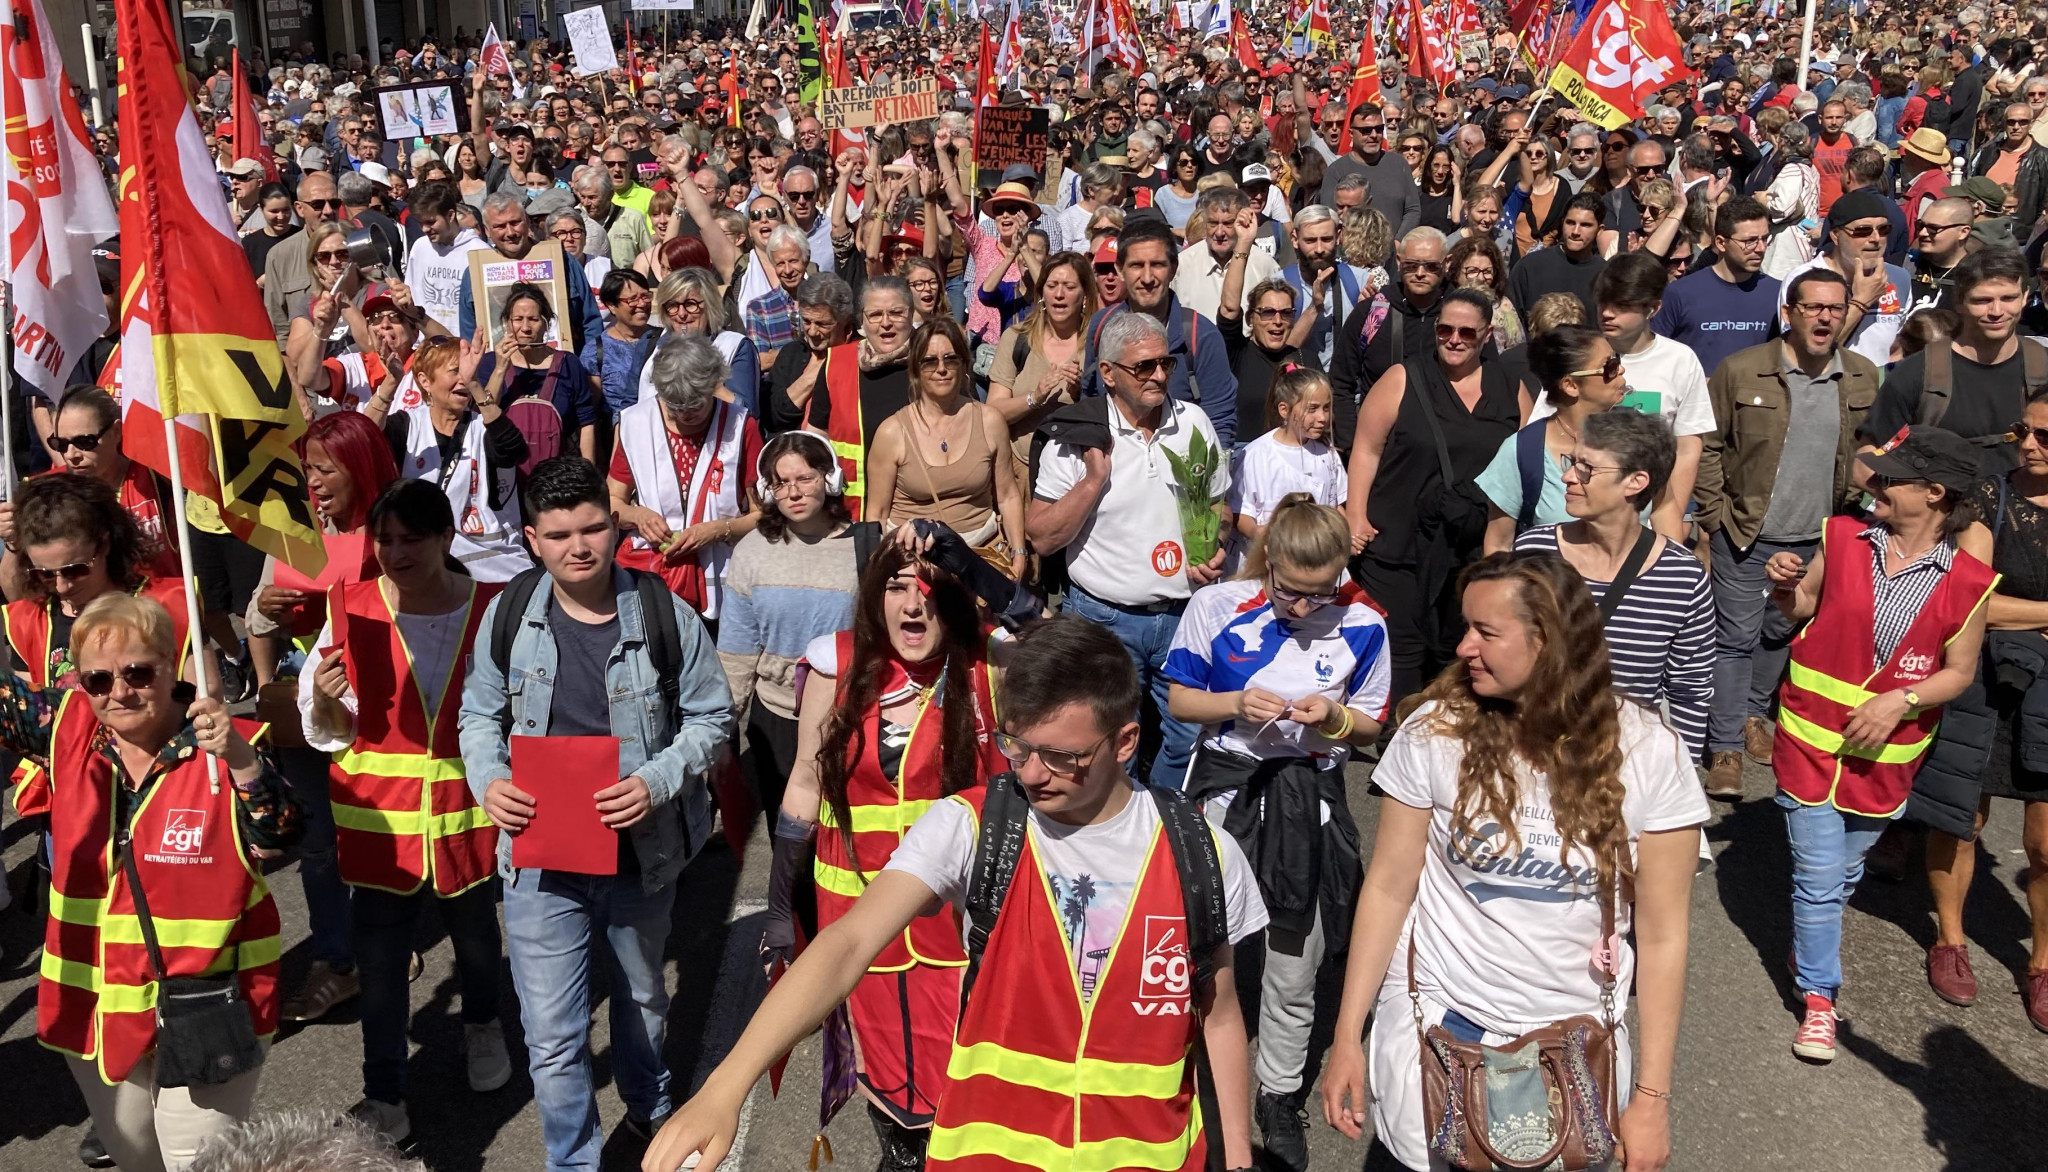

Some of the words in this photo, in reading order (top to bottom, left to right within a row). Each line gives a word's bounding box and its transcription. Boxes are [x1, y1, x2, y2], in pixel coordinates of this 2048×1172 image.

[823, 90, 839, 104] LA
[842, 83, 897, 102] REFORME
[901, 78, 934, 95] DOIT
[824, 100, 873, 115] BATTRE
[824, 115, 846, 129] EN
[874, 93, 936, 123] RETRAITE
[1585, 97, 1612, 122] PACA
[982, 118, 1004, 131] PAR
[1007, 121, 1023, 133] LA
[1025, 133, 1047, 148] LES
[1032, 150, 1047, 163] SE
[427, 266, 462, 281] KAPORAL
[1878, 290, 1898, 305] cgt
[1700, 320, 1767, 331] carhartt
[13, 304, 65, 378] ARTIN
[1156, 550, 1177, 571] 60
[163, 826, 203, 852] cgt
[1528, 832, 1561, 847] DEVIE
[144, 853, 188, 865] RETRAITÉ(ES)
[189, 856, 199, 864] DU
[199, 856, 213, 864] VAR
[1446, 816, 1600, 890] Vintage
[1147, 927, 1188, 956] la
[1143, 955, 1190, 993] cg
